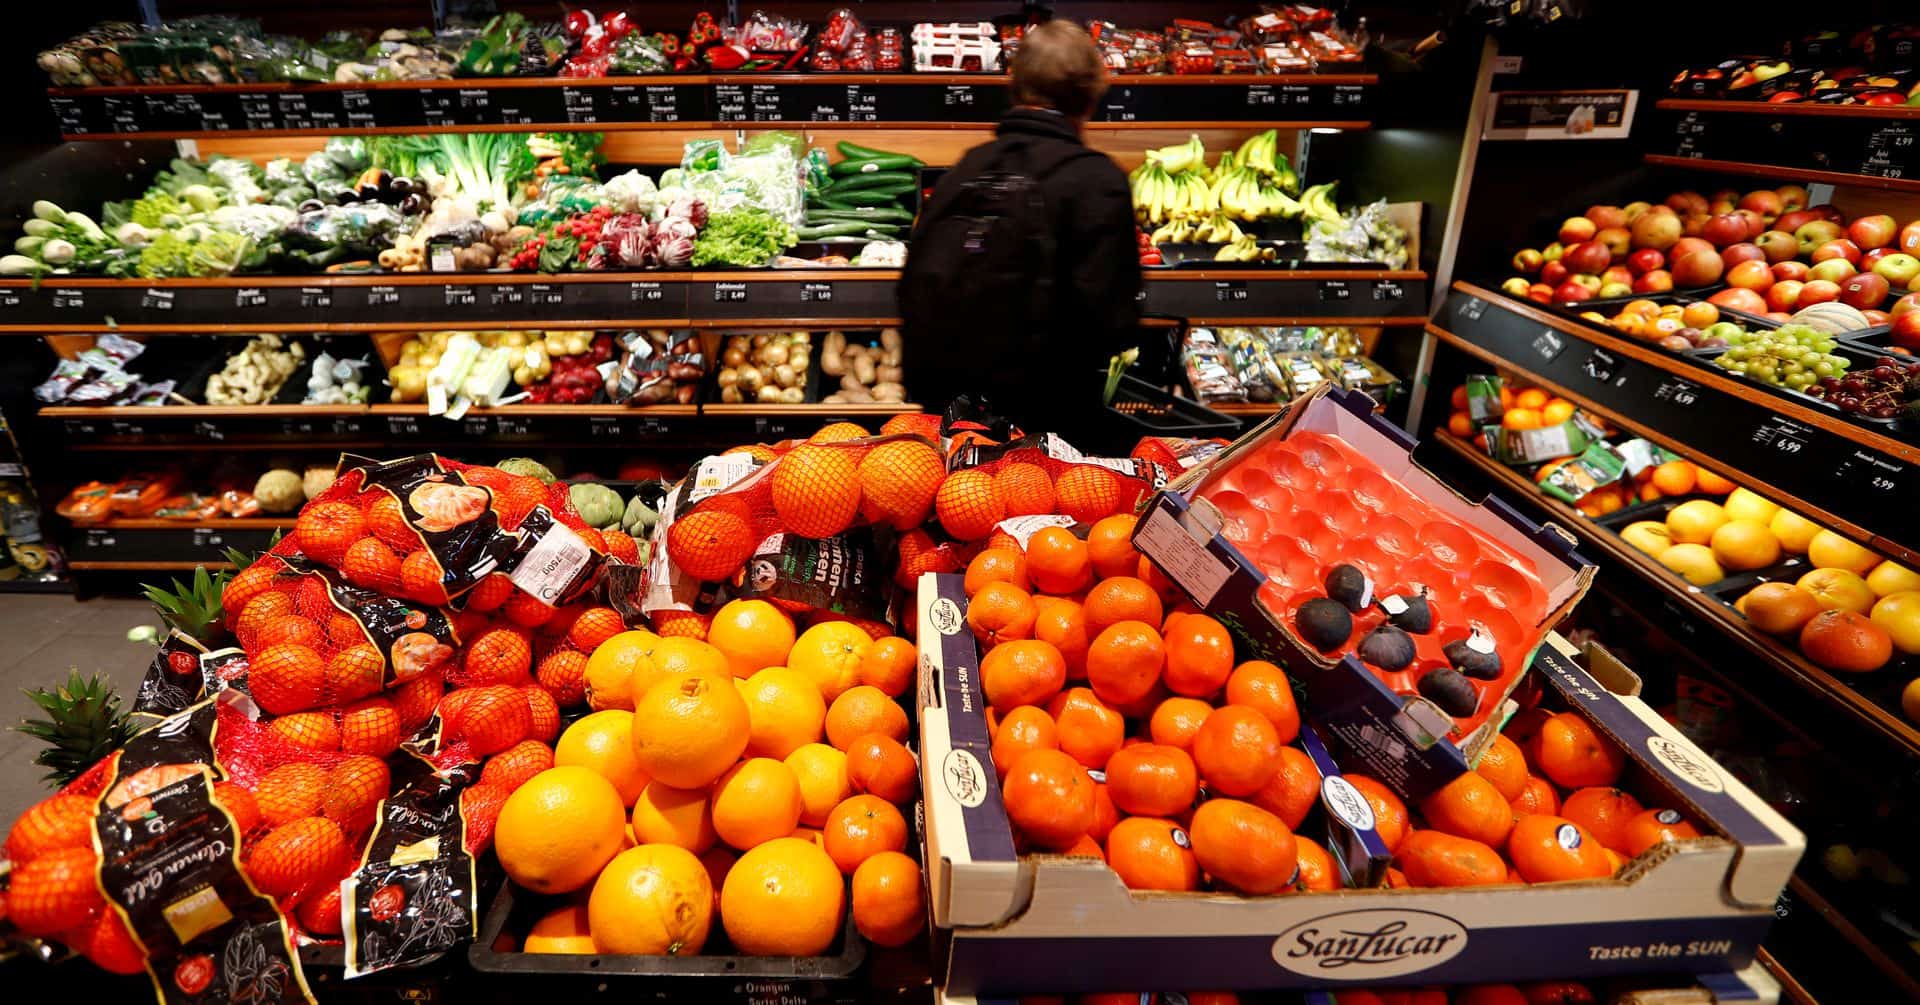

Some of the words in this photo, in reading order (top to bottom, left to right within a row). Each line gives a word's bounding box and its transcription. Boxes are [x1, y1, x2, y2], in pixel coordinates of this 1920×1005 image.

[1895, 137, 1913, 146] 2,99
[1882, 168, 1902, 178] 2,99
[1777, 438, 1802, 453] 6,99
[1871, 477, 1895, 490] 2,99
[829, 536, 845, 597] onnen-
[958, 666, 969, 682] SUN
[1543, 655, 1566, 674] Taste
[1563, 674, 1581, 687] the
[1577, 687, 1601, 701] SUN
[950, 752, 980, 802] SanLucar
[1286, 919, 1458, 969] SanLucar
[1588, 945, 1643, 960] Taste
[1647, 942, 1683, 958] the
[1684, 940, 1732, 956] SUN
